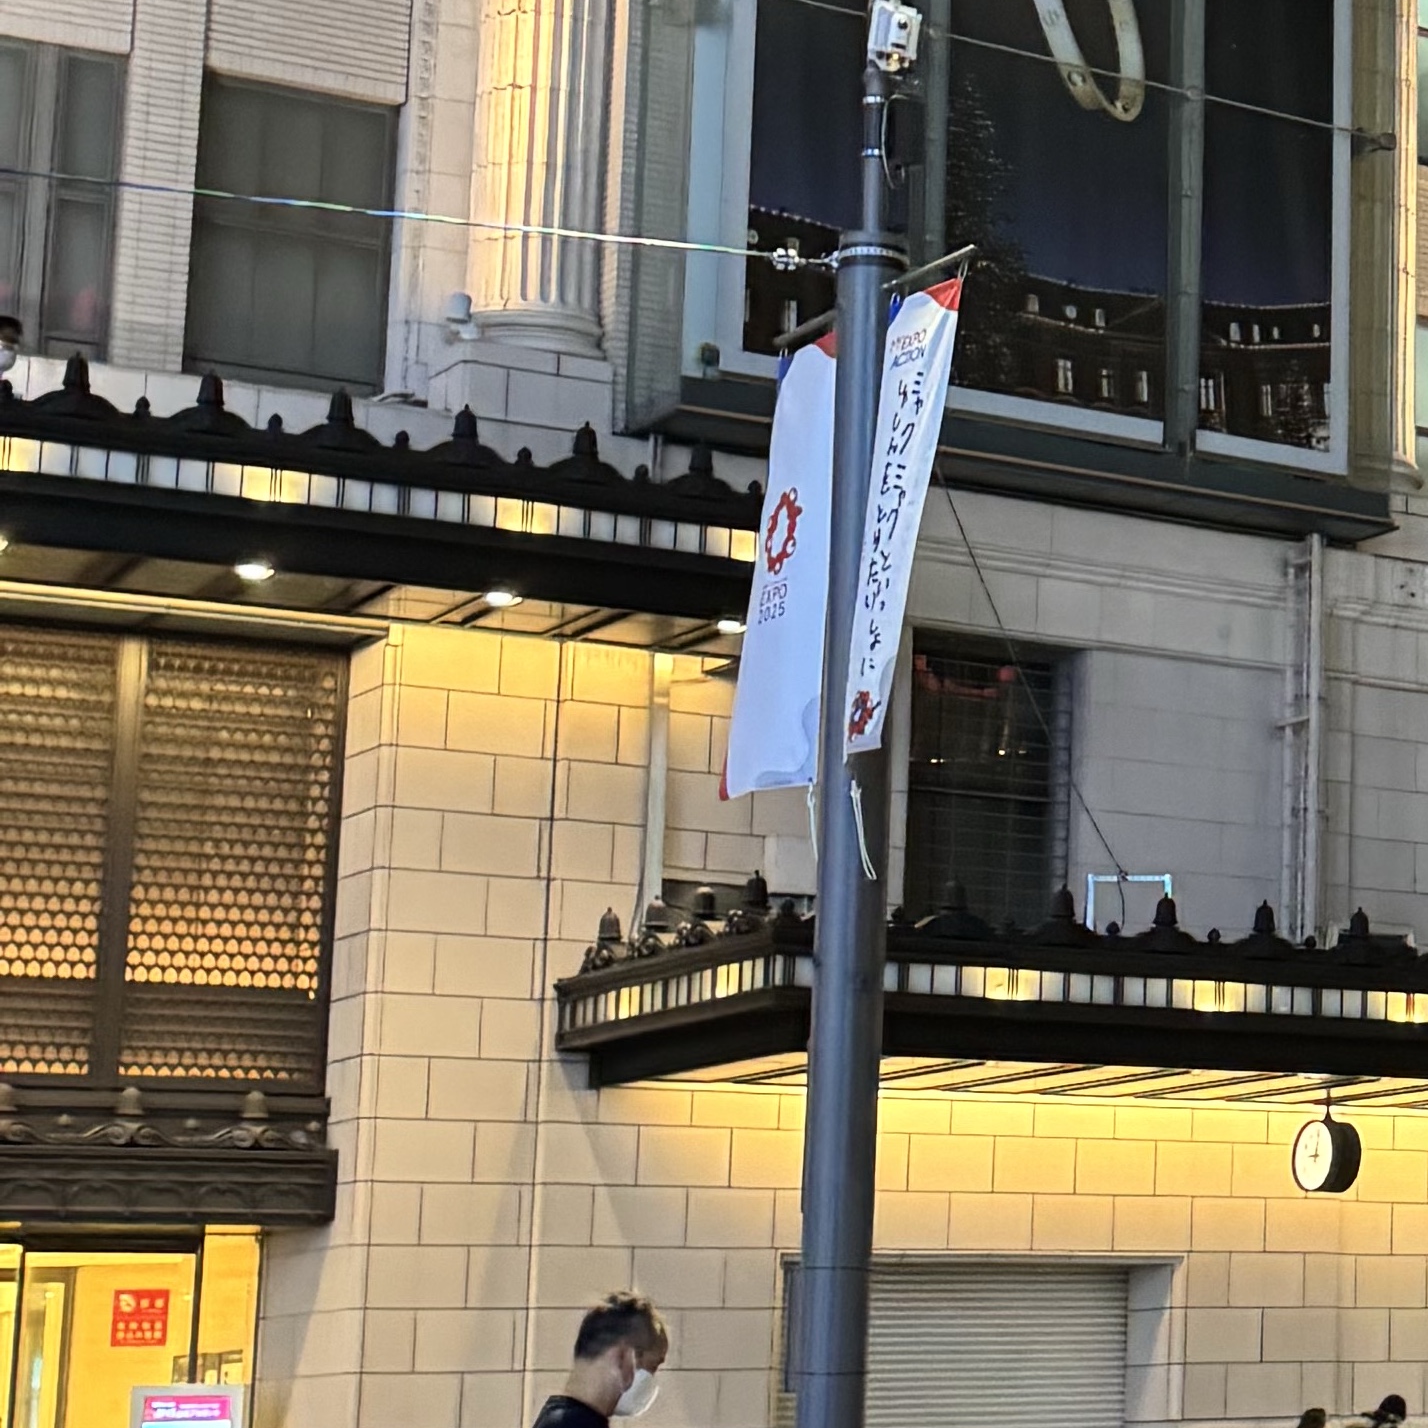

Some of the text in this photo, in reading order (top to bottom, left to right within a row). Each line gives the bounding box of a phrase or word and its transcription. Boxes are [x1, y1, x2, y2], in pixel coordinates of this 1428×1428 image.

[901, 328, 927, 350] EXPO
[889, 344, 927, 370] ACTION
[760, 582, 788, 607] EXPO
[758, 600, 786, 625] 2025
